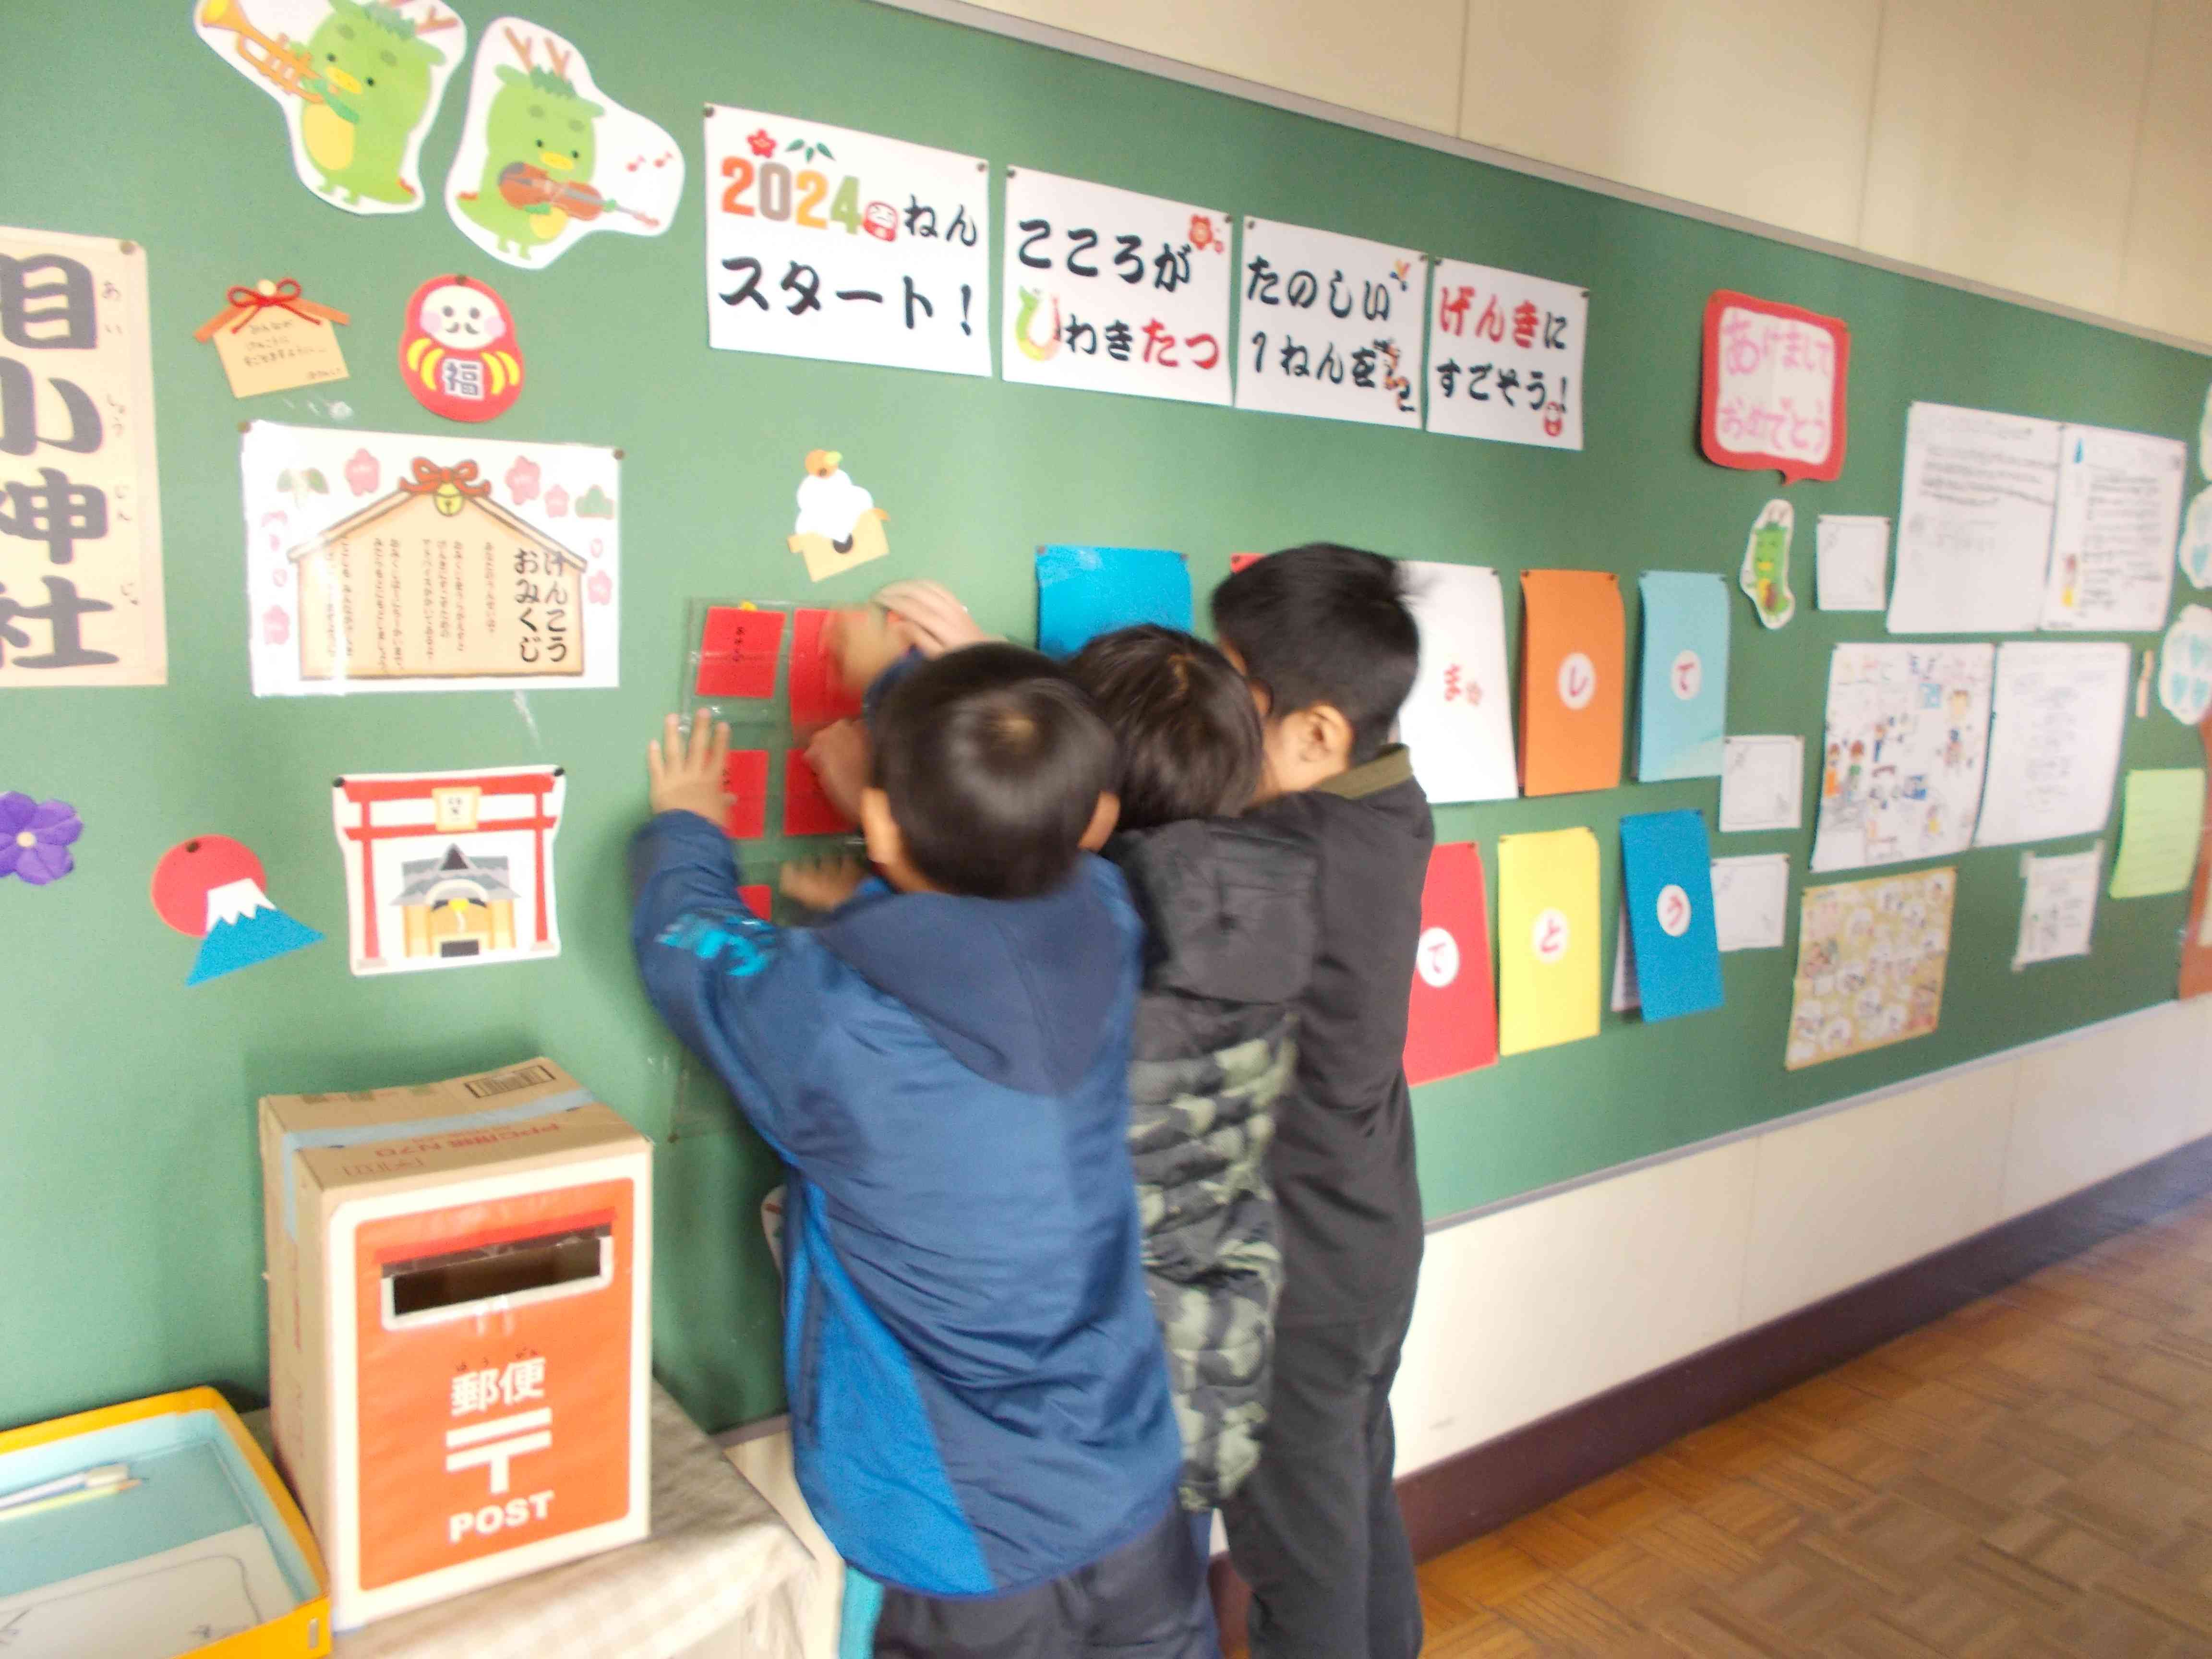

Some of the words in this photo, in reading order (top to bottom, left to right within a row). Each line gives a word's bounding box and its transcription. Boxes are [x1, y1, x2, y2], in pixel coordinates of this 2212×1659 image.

[721, 156, 863, 235] 2024
[904, 193, 977, 246] ねん
[1018, 218, 1191, 292] こころが
[1248, 255, 1390, 321] たのしい
[720, 256, 972, 336] スタート！
[1441, 286, 1567, 349] げんきに
[446, 362, 478, 395] 福
[514, 548, 541, 662] おみくじ
[544, 551, 567, 661] けんこう
[450, 1357, 546, 1417] 郵便
[448, 1489, 555, 1544] POST
